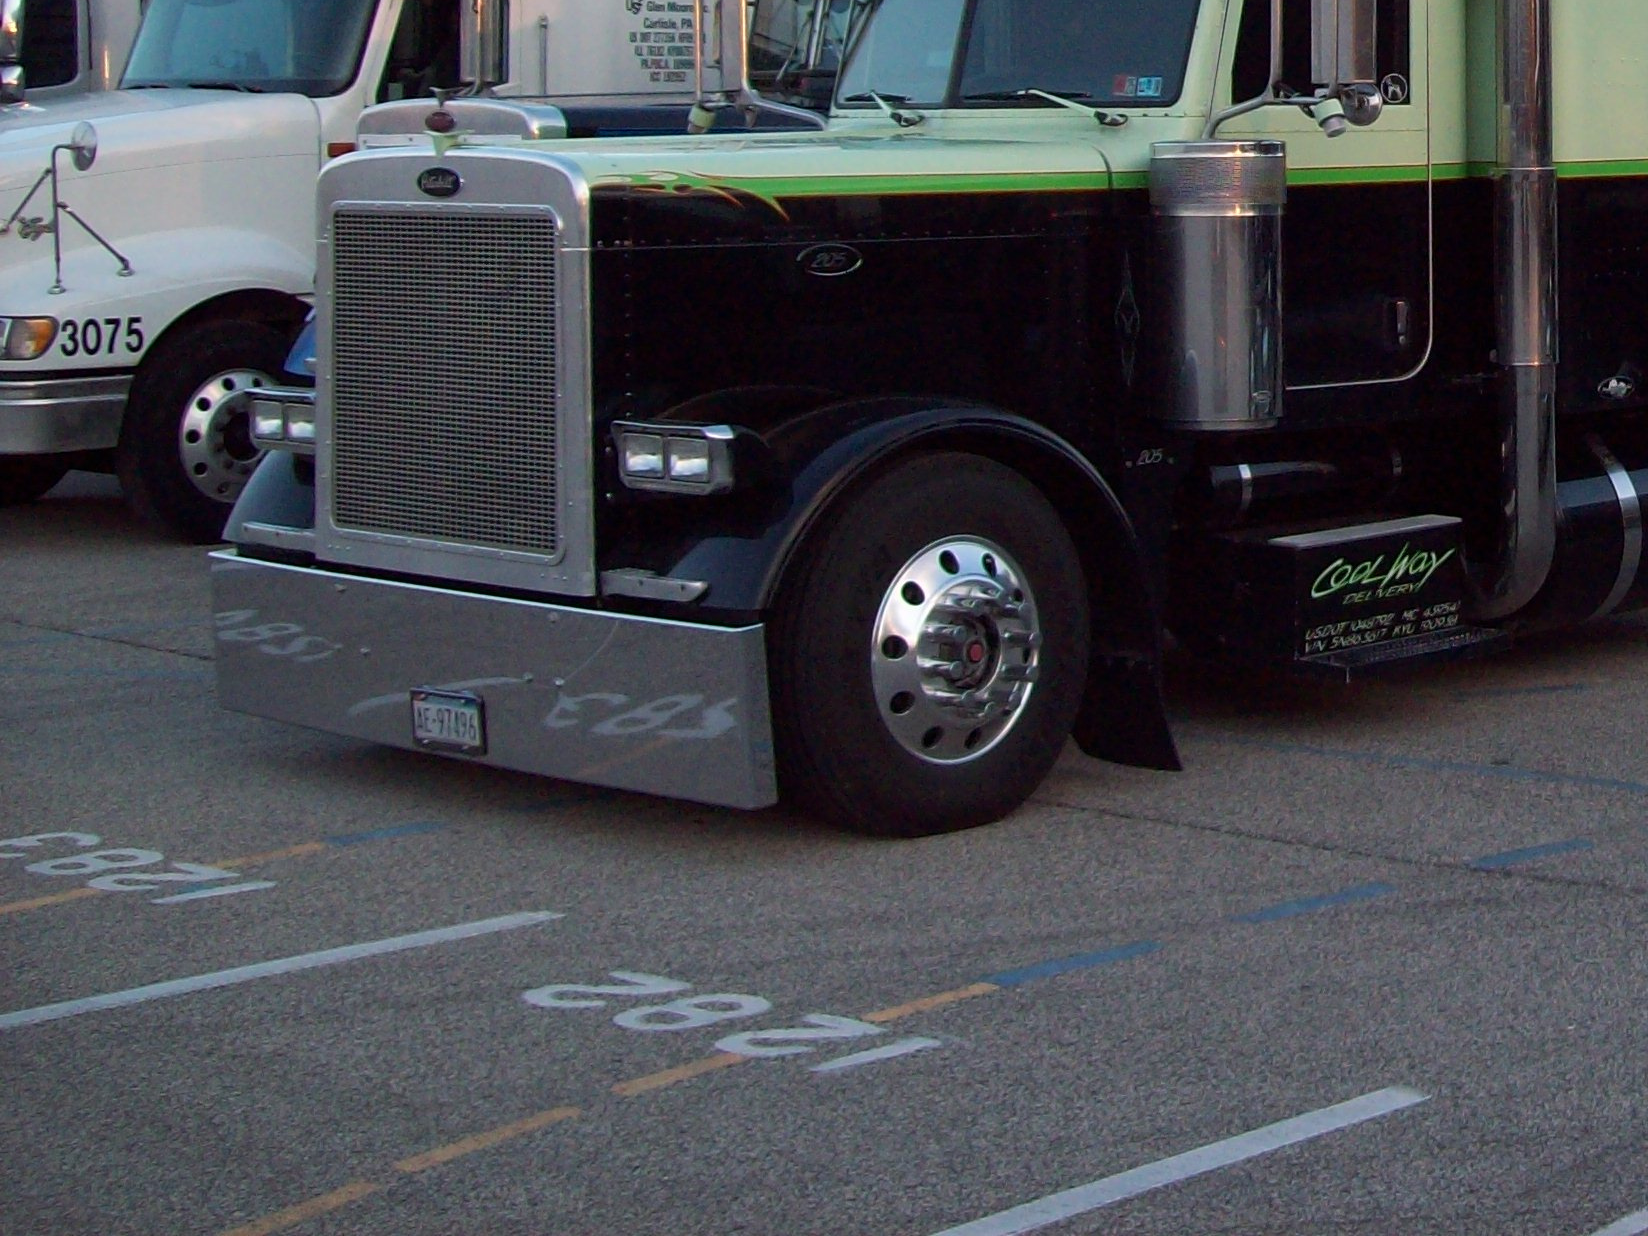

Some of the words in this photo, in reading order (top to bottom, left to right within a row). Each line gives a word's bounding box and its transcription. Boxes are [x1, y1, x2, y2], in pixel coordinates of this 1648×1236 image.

[647, 0, 665, 13] Glen
[61, 316, 144, 356] 3075
[521, 970, 942, 1072] 1282
